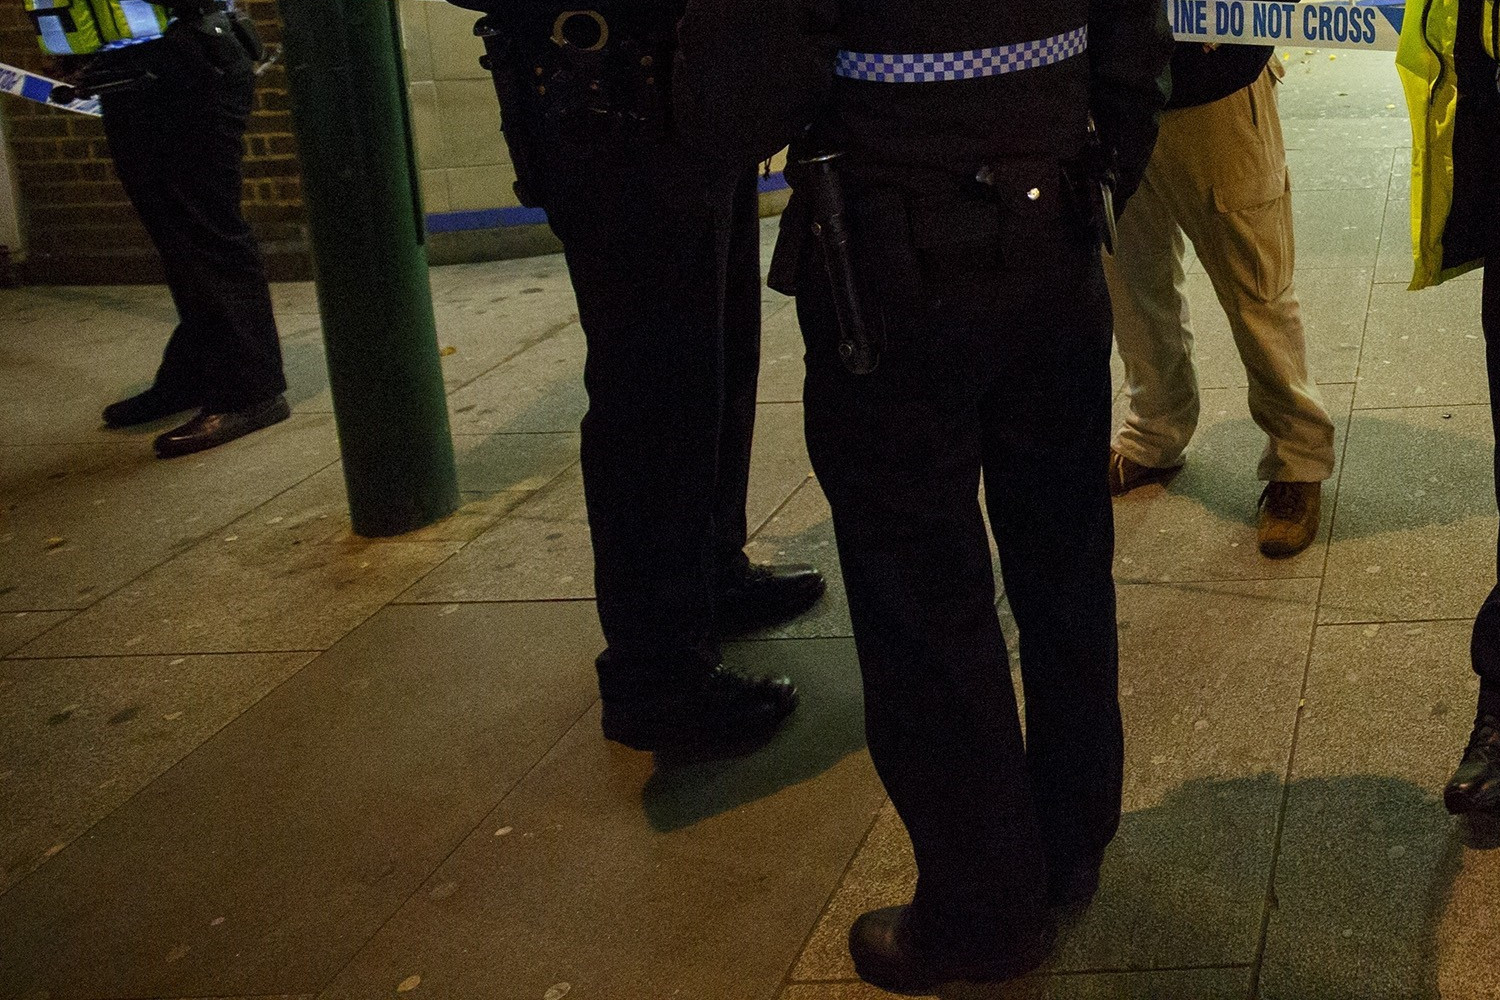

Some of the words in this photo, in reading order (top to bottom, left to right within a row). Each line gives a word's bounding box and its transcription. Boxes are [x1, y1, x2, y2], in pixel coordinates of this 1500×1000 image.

[1169, 0, 1207, 35] INE
[1215, 1, 1244, 37] DO
[1253, 3, 1295, 39] NOT
[1303, 4, 1376, 44] CROSS
